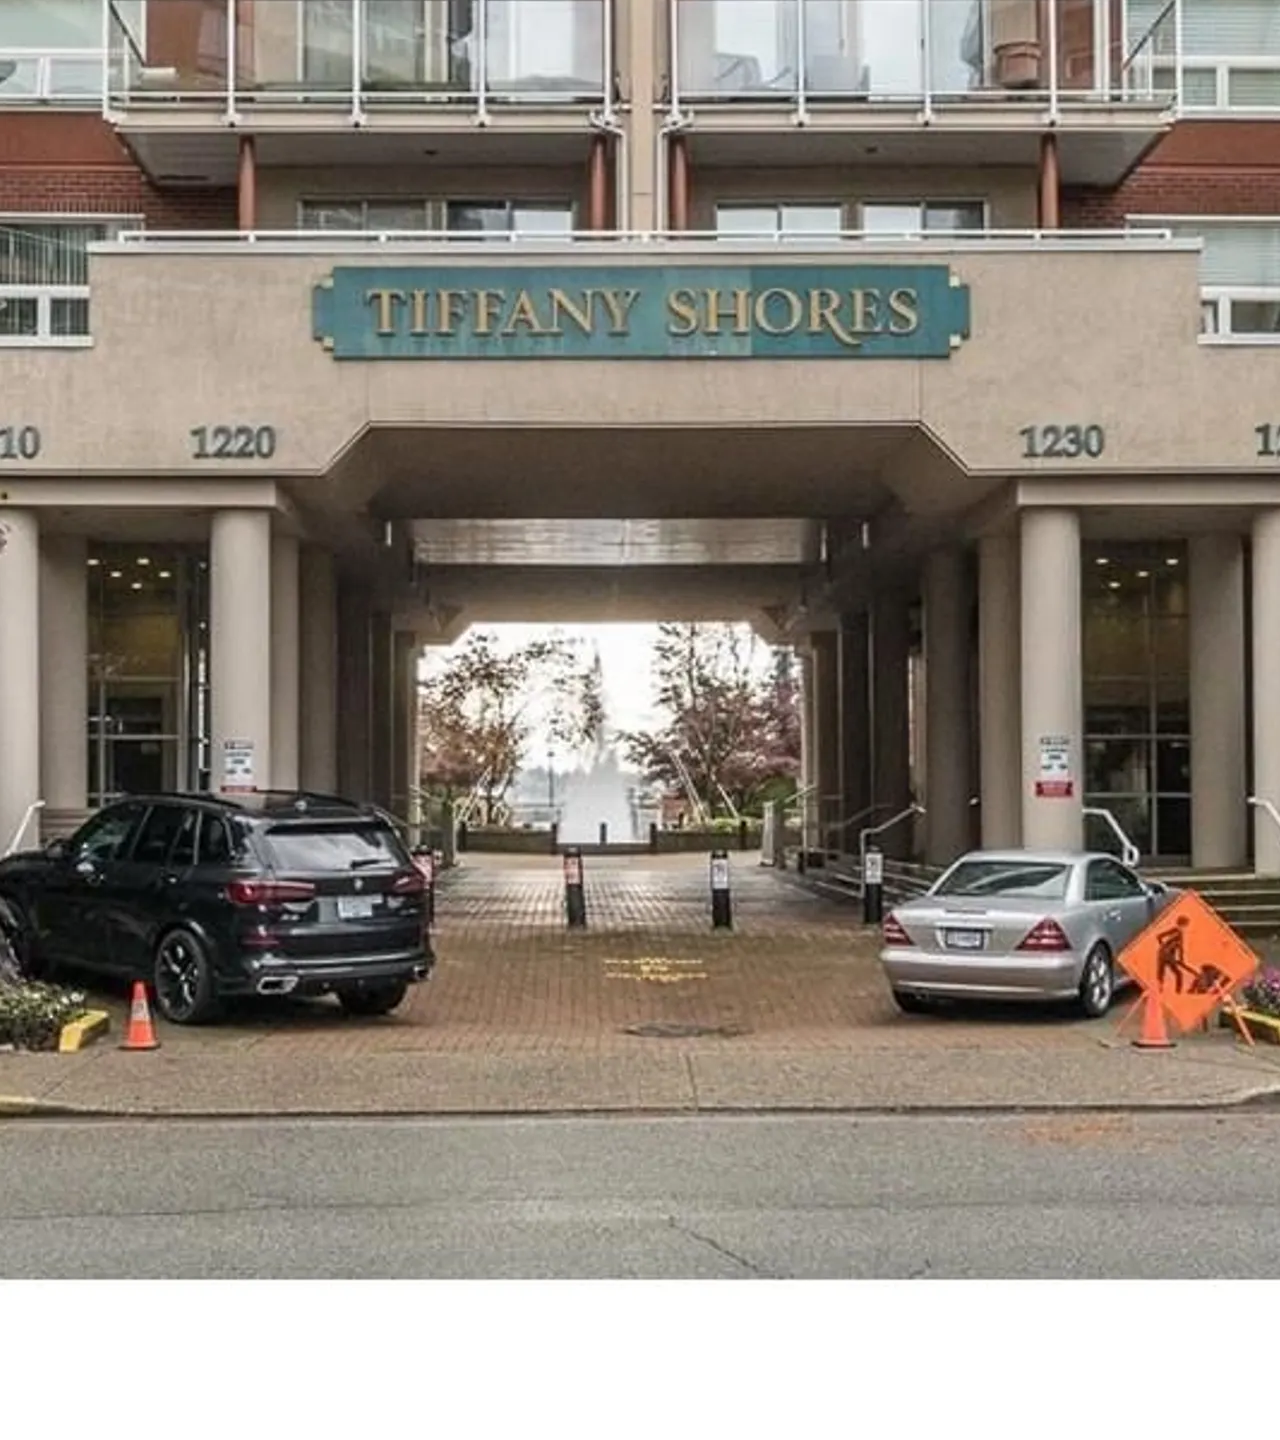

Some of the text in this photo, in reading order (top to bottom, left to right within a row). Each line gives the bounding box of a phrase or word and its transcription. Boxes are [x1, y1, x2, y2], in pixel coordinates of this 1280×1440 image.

[365, 286, 921, 346] TIFFANY SHORES
[190, 425, 276, 459] 1220
[1019, 424, 1105, 459] 1230
